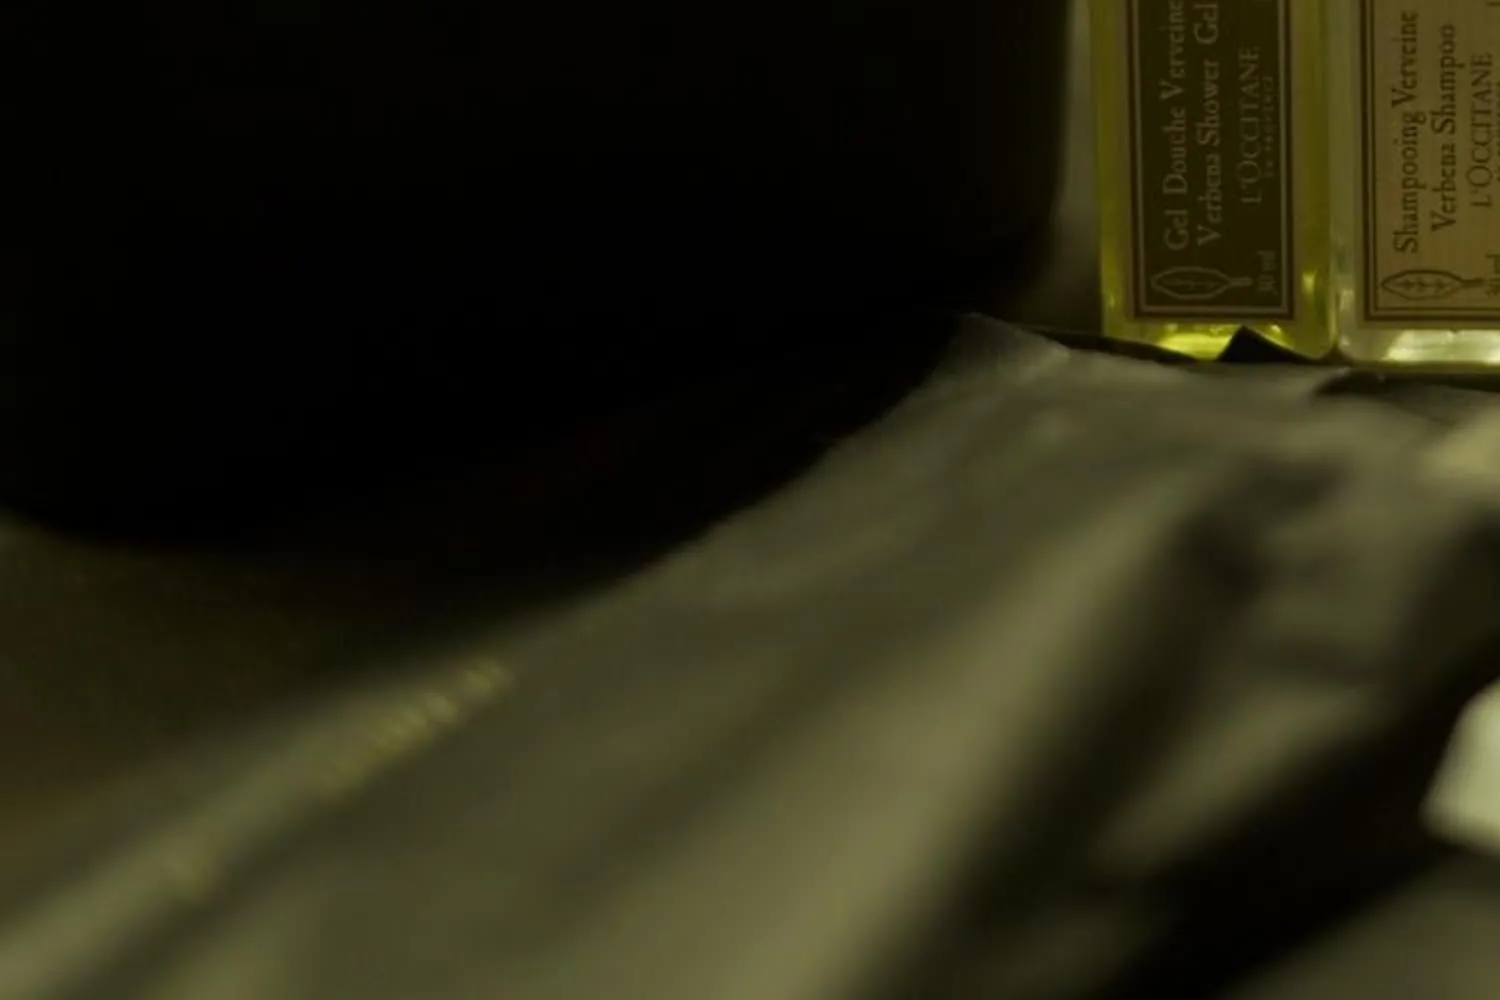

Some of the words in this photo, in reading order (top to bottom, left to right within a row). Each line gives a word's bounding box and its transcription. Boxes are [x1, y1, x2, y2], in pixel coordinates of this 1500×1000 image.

[1159, 0, 1186, 100] Verveine
[1194, 2, 1220, 45] Gel
[1392, 11, 1419, 106] Verveine
[1196, 59, 1221, 146] Shower
[1432, 24, 1464, 135] Shampoo
[1161, 107, 1189, 195] Douche
[1394, 111, 1426, 254] Shampooing
[1431, 143, 1457, 231] Verbena
[1164, 208, 1190, 250] Gel
[1197, 153, 1223, 246] Verbena
